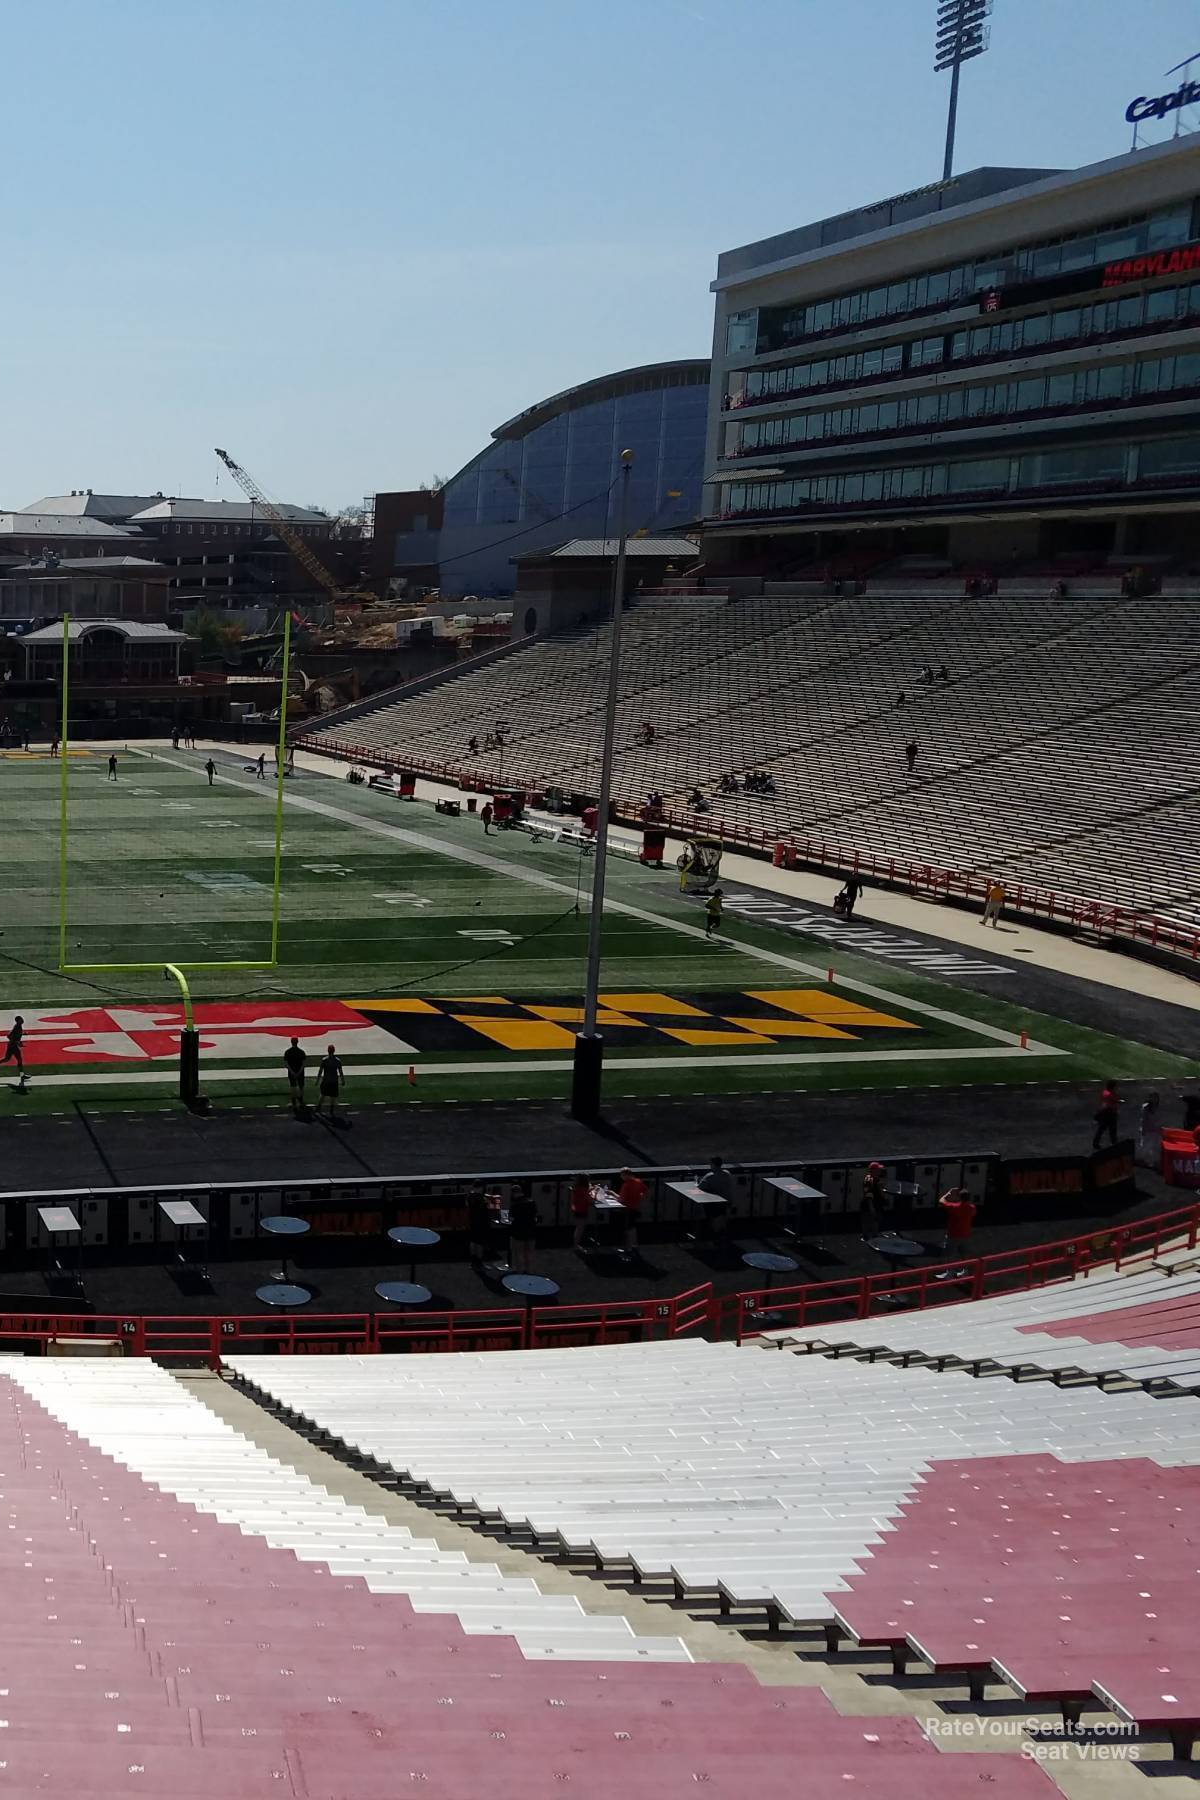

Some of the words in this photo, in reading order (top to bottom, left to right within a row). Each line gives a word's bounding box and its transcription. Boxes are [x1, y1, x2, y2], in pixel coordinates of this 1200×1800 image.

[744, 1298, 755, 1308] 16
[657, 1306, 670, 1316] 15
[123, 1323, 136, 1333] 14
[222, 1323, 235, 1333] 15
